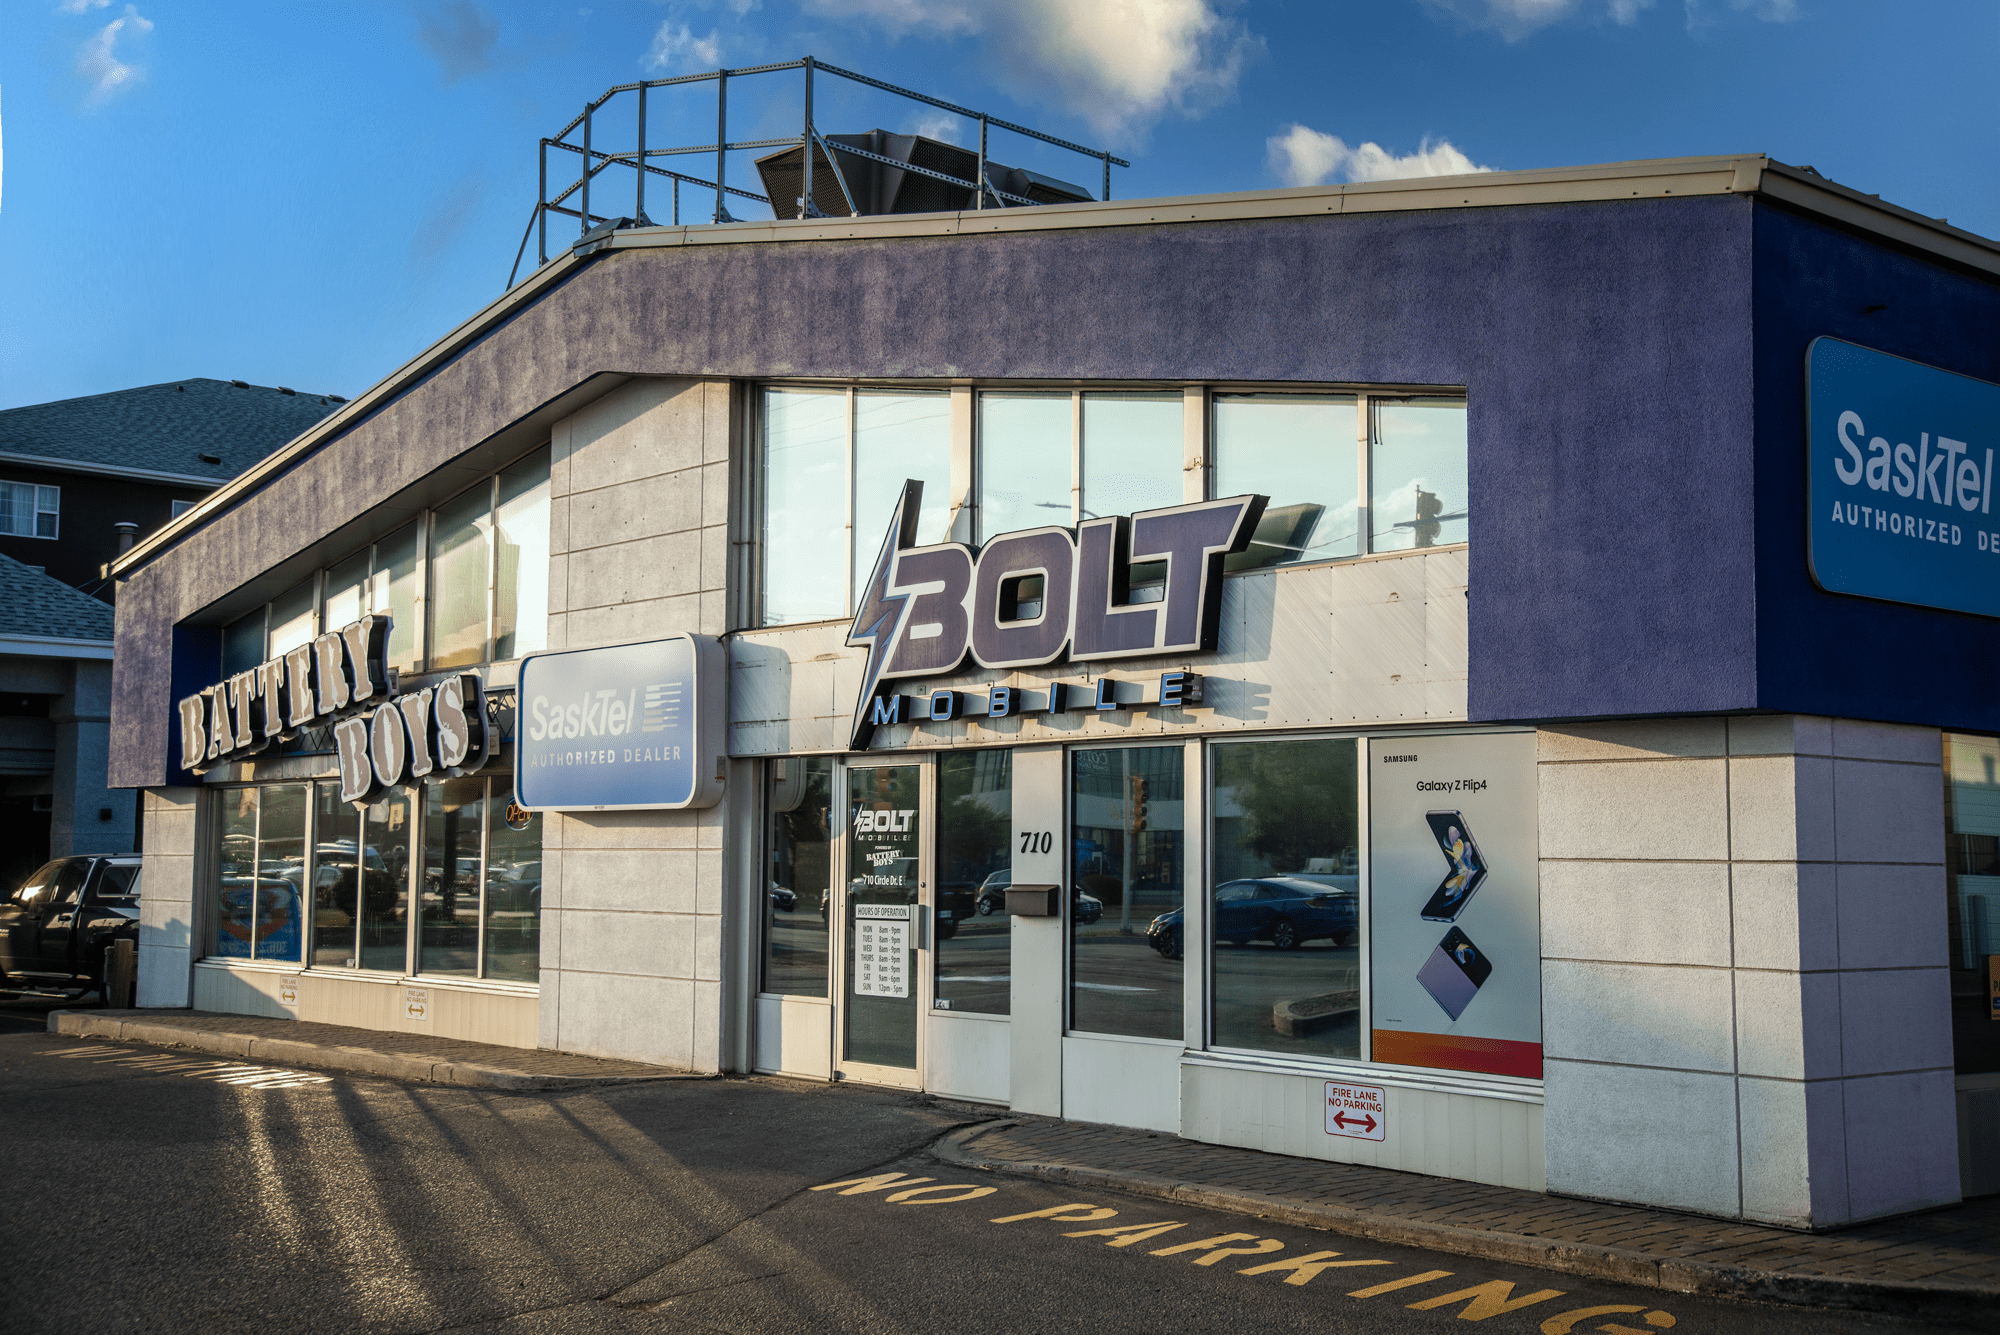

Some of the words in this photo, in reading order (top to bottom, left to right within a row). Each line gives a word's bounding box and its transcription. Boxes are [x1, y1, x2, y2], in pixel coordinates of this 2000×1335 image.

[1834, 410, 1993, 514] SaskTel
[1831, 500, 1962, 546] AUTHORIZED
[878, 494, 1258, 679] BOLT
[178, 614, 375, 770] BATTERY
[872, 671, 1187, 726] MOBILE
[529, 687, 637, 741] SaskTel
[334, 673, 470, 803] BOYS
[530, 749, 616, 767] AUTHORIZED
[623, 746, 681, 762] DEALER
[1383, 754, 1418, 763] SAMSUNG
[1416, 780, 1453, 793] Galaxy
[1454, 779, 1461, 791] Z
[1462, 779, 1487, 793] Flip4
[859, 810, 915, 832] BOLT
[1020, 831, 1052, 854] 710
[866, 849, 900, 861] BATTERY
[873, 858, 894, 867] BOYS
[863, 874, 874, 885] 710
[858, 907, 873, 915] HOURS
[874, 907, 880, 915] OF
[881, 907, 907, 916] OPERATION
[1328, 1097, 1341, 1107] NO
[1344, 1099, 1382, 1112] PARKING
[1333, 1088, 1351, 1098] FIRE
[1354, 1090, 1377, 1101] LANE
[810, 1172, 998, 1204] NO
[990, 1203, 1677, 1335] PARKING
